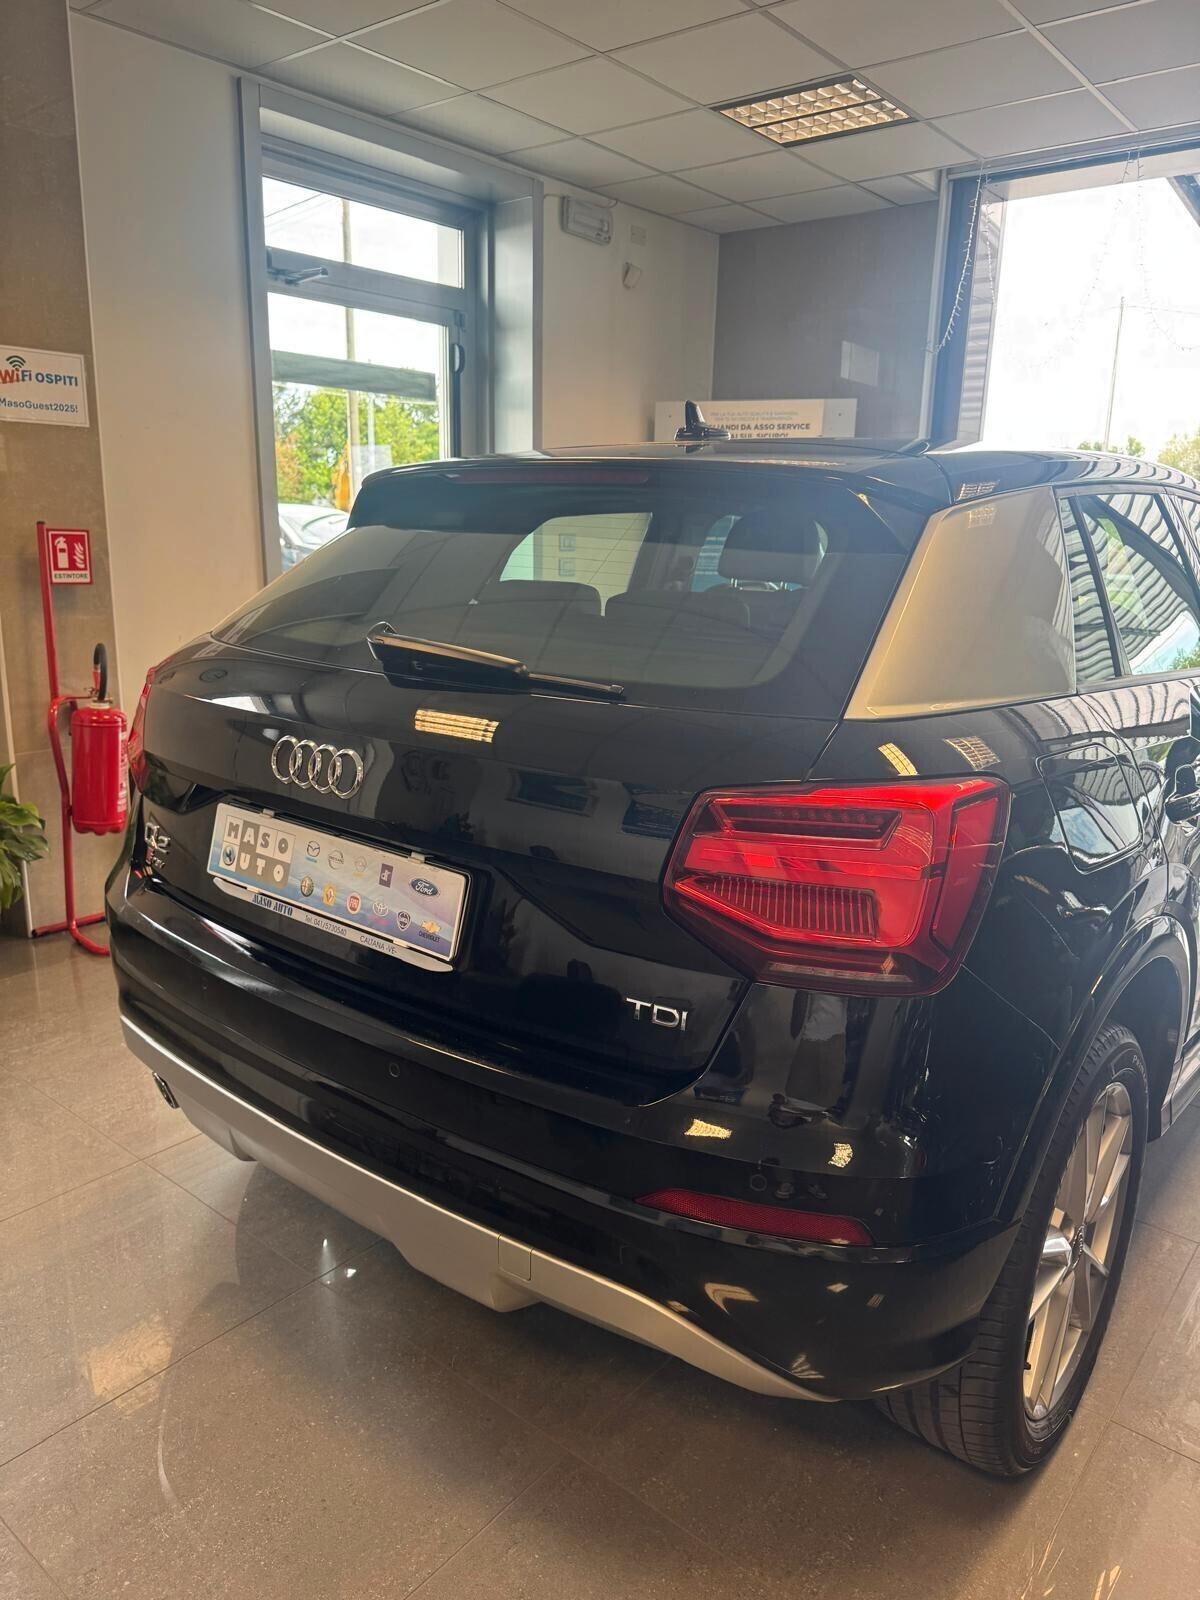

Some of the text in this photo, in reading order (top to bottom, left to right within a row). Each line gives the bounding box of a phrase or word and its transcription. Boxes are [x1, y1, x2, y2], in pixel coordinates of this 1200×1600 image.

[35, 372, 78, 387] OSPITI
[53, 572, 88, 580] ESTINTORE
[227, 821, 289, 855] MASO
[415, 880, 435, 895] Ford
[273, 901, 293, 916] AUTO
[625, 997, 689, 1031] TDI
